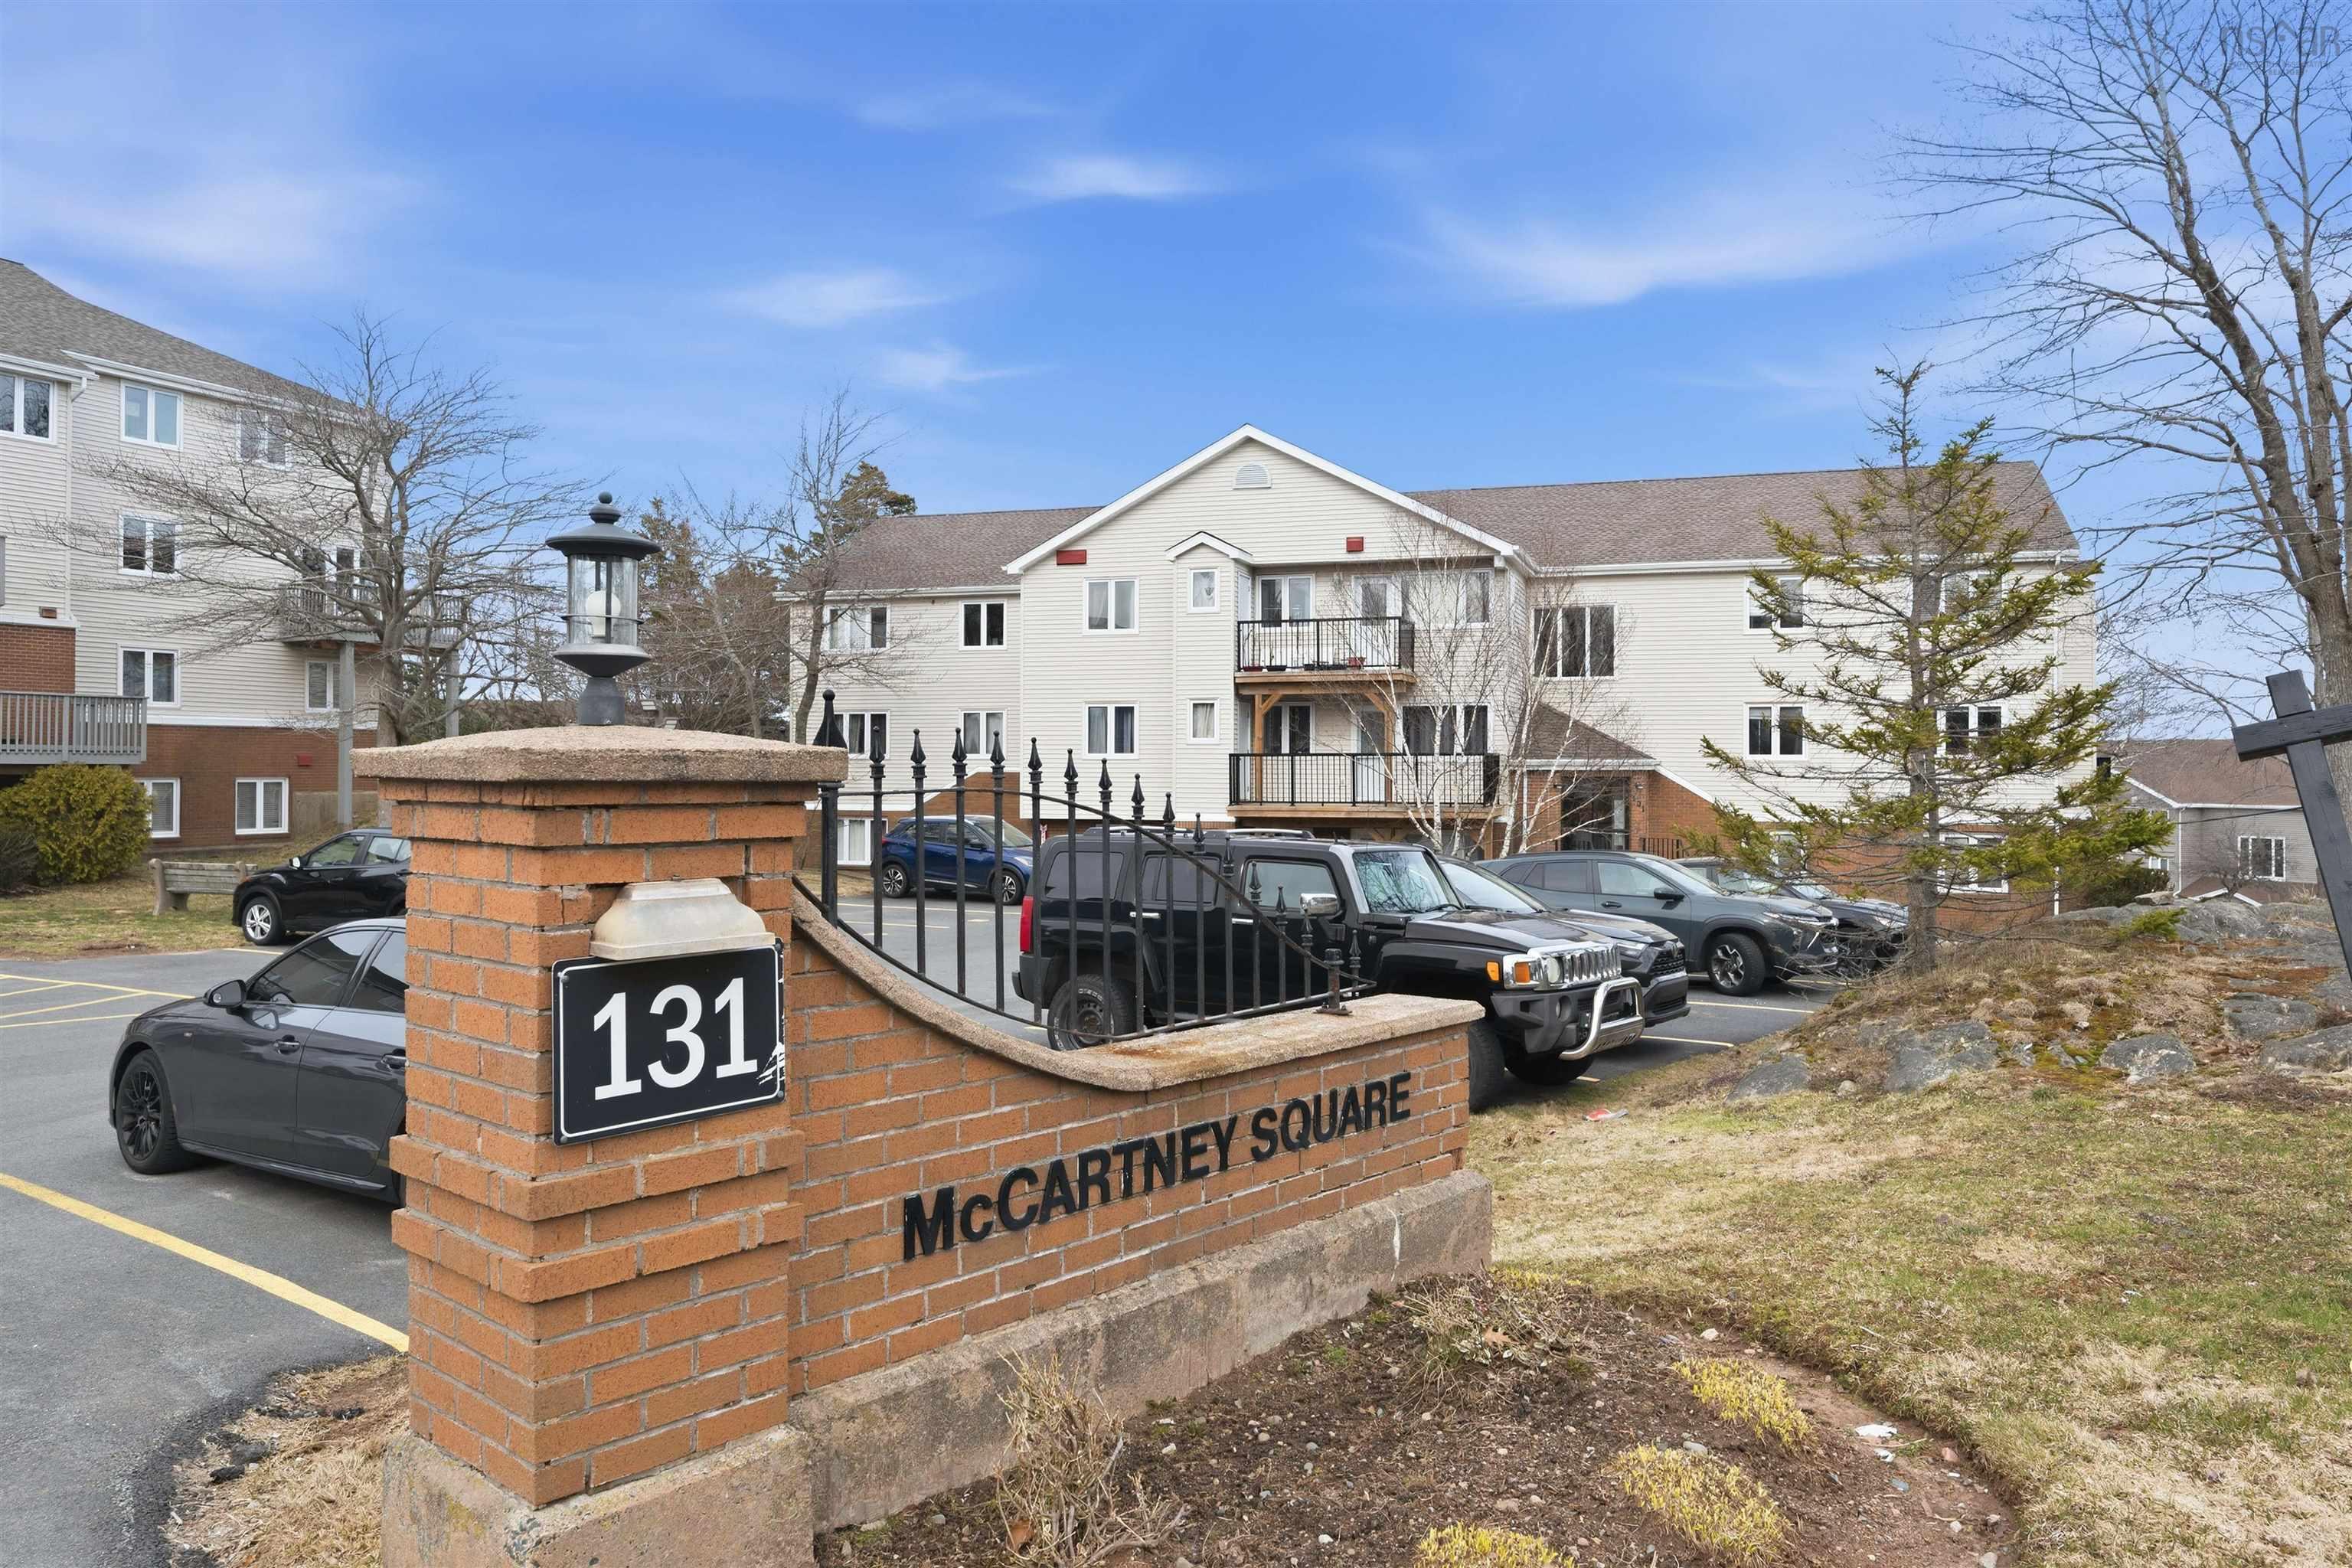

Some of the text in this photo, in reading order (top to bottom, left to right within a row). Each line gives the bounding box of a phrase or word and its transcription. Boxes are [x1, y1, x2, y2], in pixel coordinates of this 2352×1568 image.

[593, 977, 758, 1100] 131
[903, 1071, 1412, 1261] McCARTNEY SQUARE
